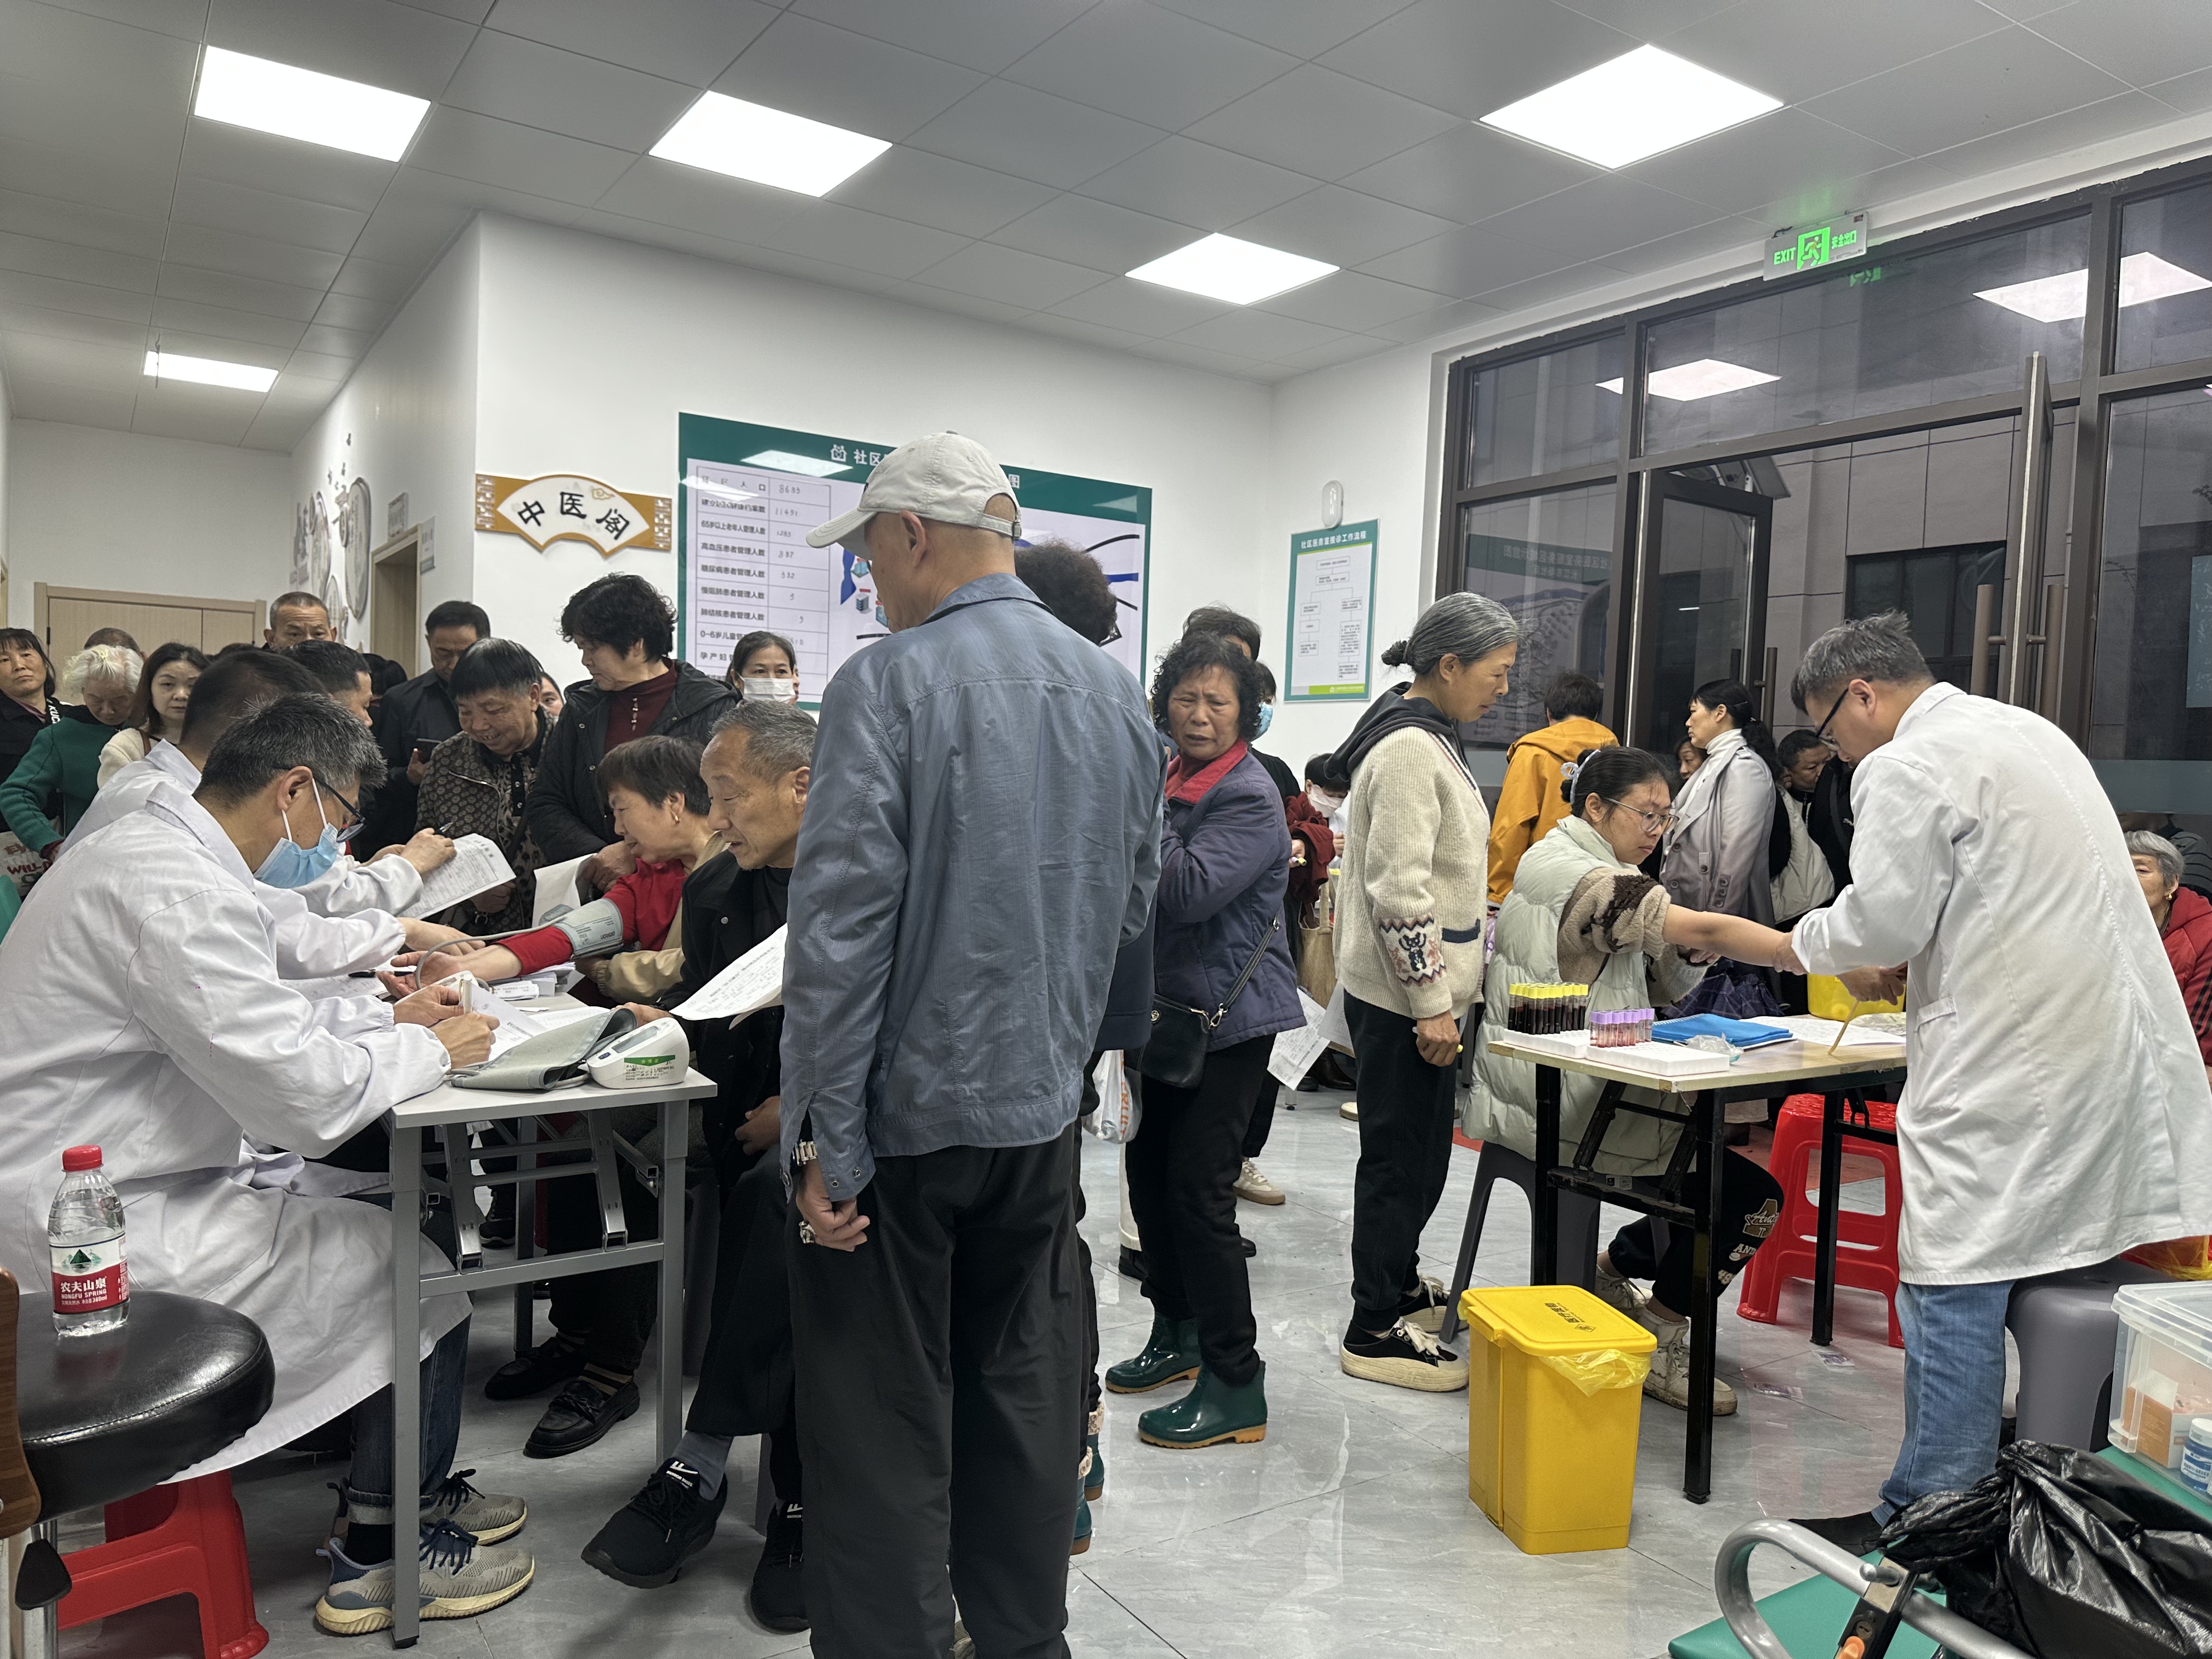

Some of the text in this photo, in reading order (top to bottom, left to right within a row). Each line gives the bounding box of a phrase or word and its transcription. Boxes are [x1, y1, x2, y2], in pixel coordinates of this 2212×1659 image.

[1831, 230, 1857, 249] 安全出口
[1774, 247, 1796, 265] EXIT
[854, 449, 888, 466] 社区
[517, 491, 630, 541] 中医阁
[701, 541, 765, 556] 高血压患者管理人数
[701, 564, 765, 578] 糖尿病患者管理人数
[700, 607, 765, 621] 肺结核患者管理人数
[60, 1277, 107, 1293] 农夫山泉
[84, 1288, 107, 1298] SPRING
